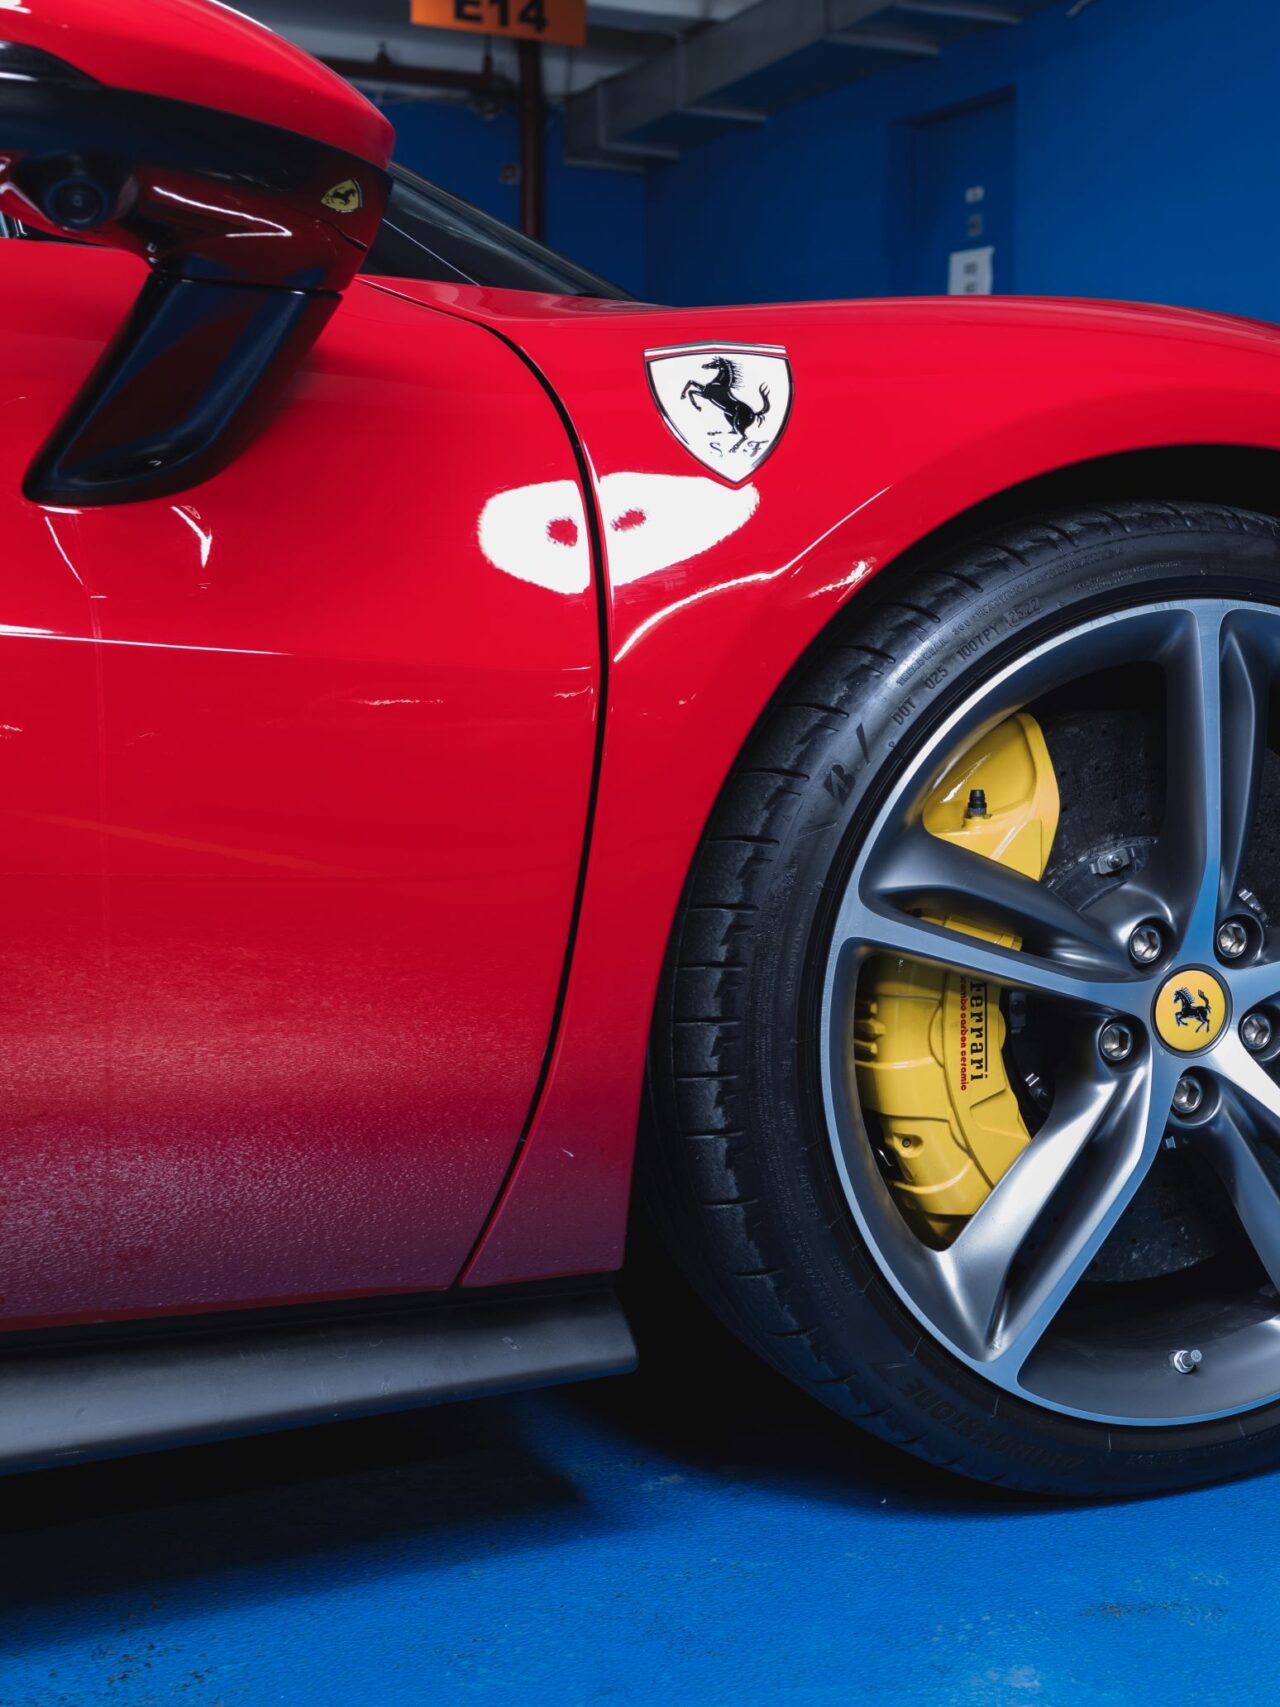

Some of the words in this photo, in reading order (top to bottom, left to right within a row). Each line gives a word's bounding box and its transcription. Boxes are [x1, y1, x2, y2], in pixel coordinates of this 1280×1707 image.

[455, 0, 548, 33] E14
[890, 696, 917, 726] DOT
[924, 667, 949, 691] 025
[960, 1013, 969, 1049] carbon
[970, 981, 988, 1082] Ferrari
[960, 1051, 970, 1091] ceramic
